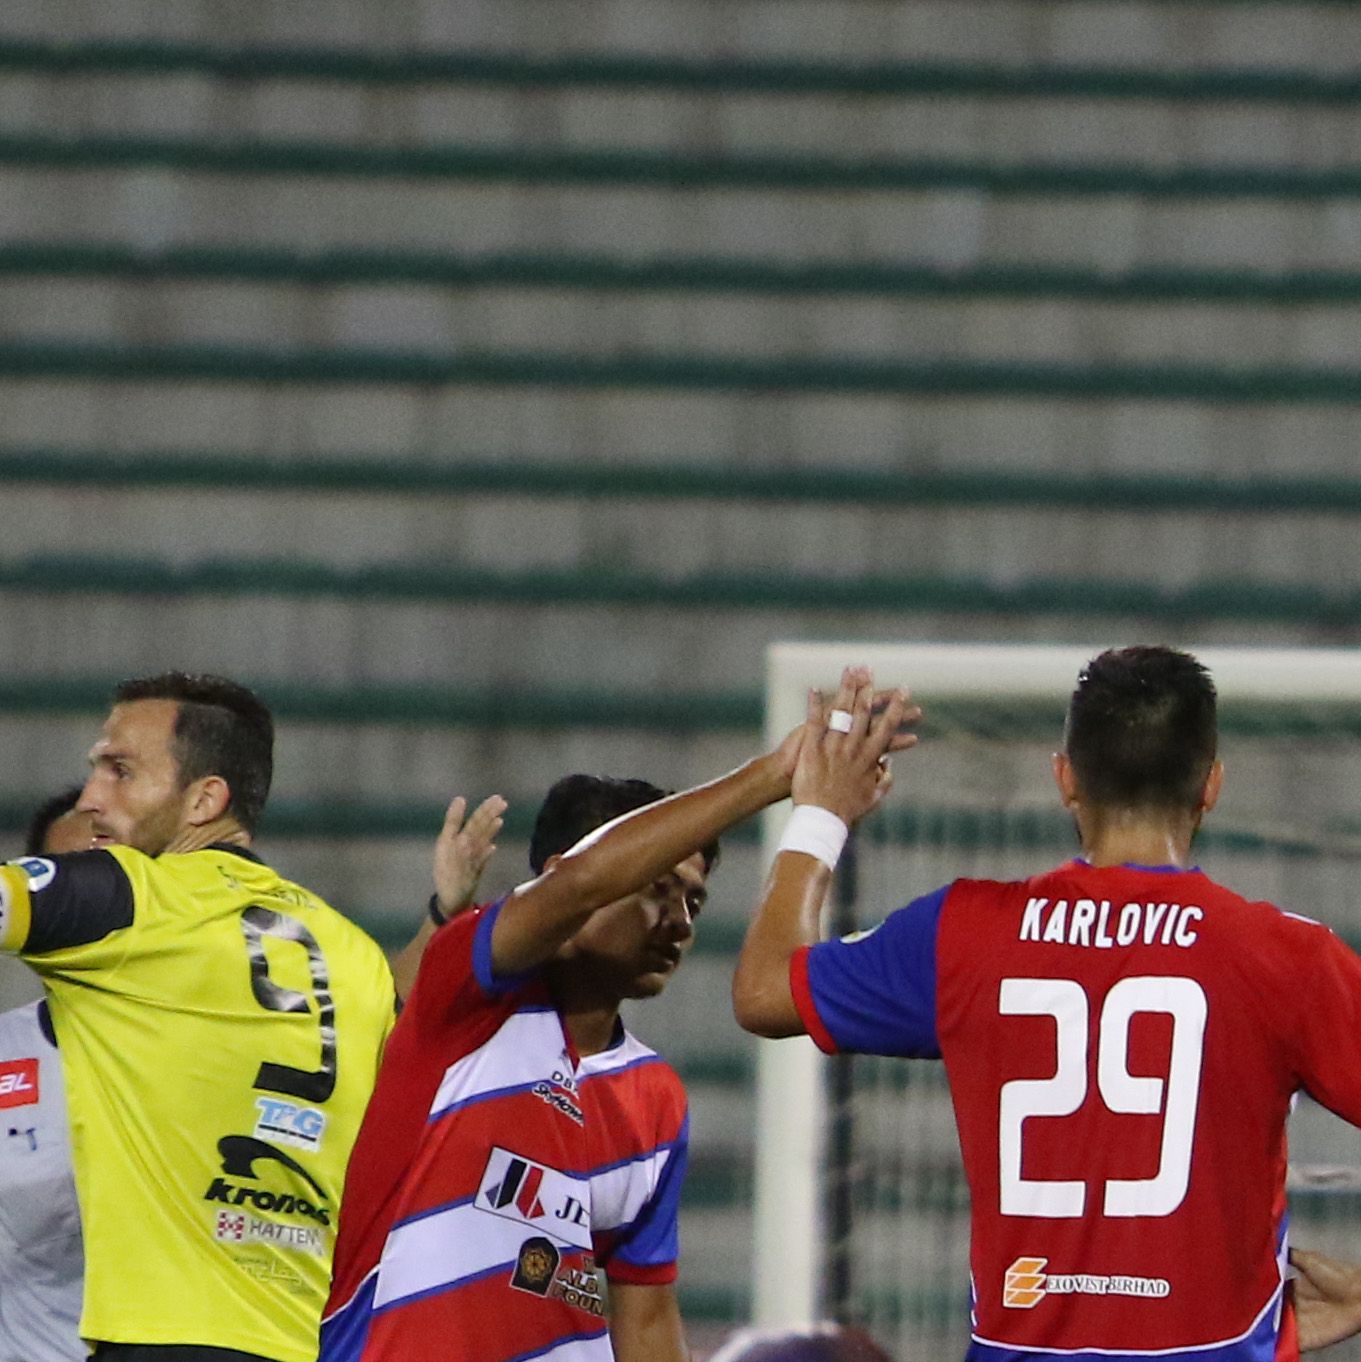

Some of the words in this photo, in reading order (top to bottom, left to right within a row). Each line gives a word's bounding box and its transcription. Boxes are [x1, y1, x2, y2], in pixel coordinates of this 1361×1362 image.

[240, 904, 337, 1103] 9
[1019, 898, 1203, 947] KARLOVIC
[999, 976, 1208, 1217] 29
